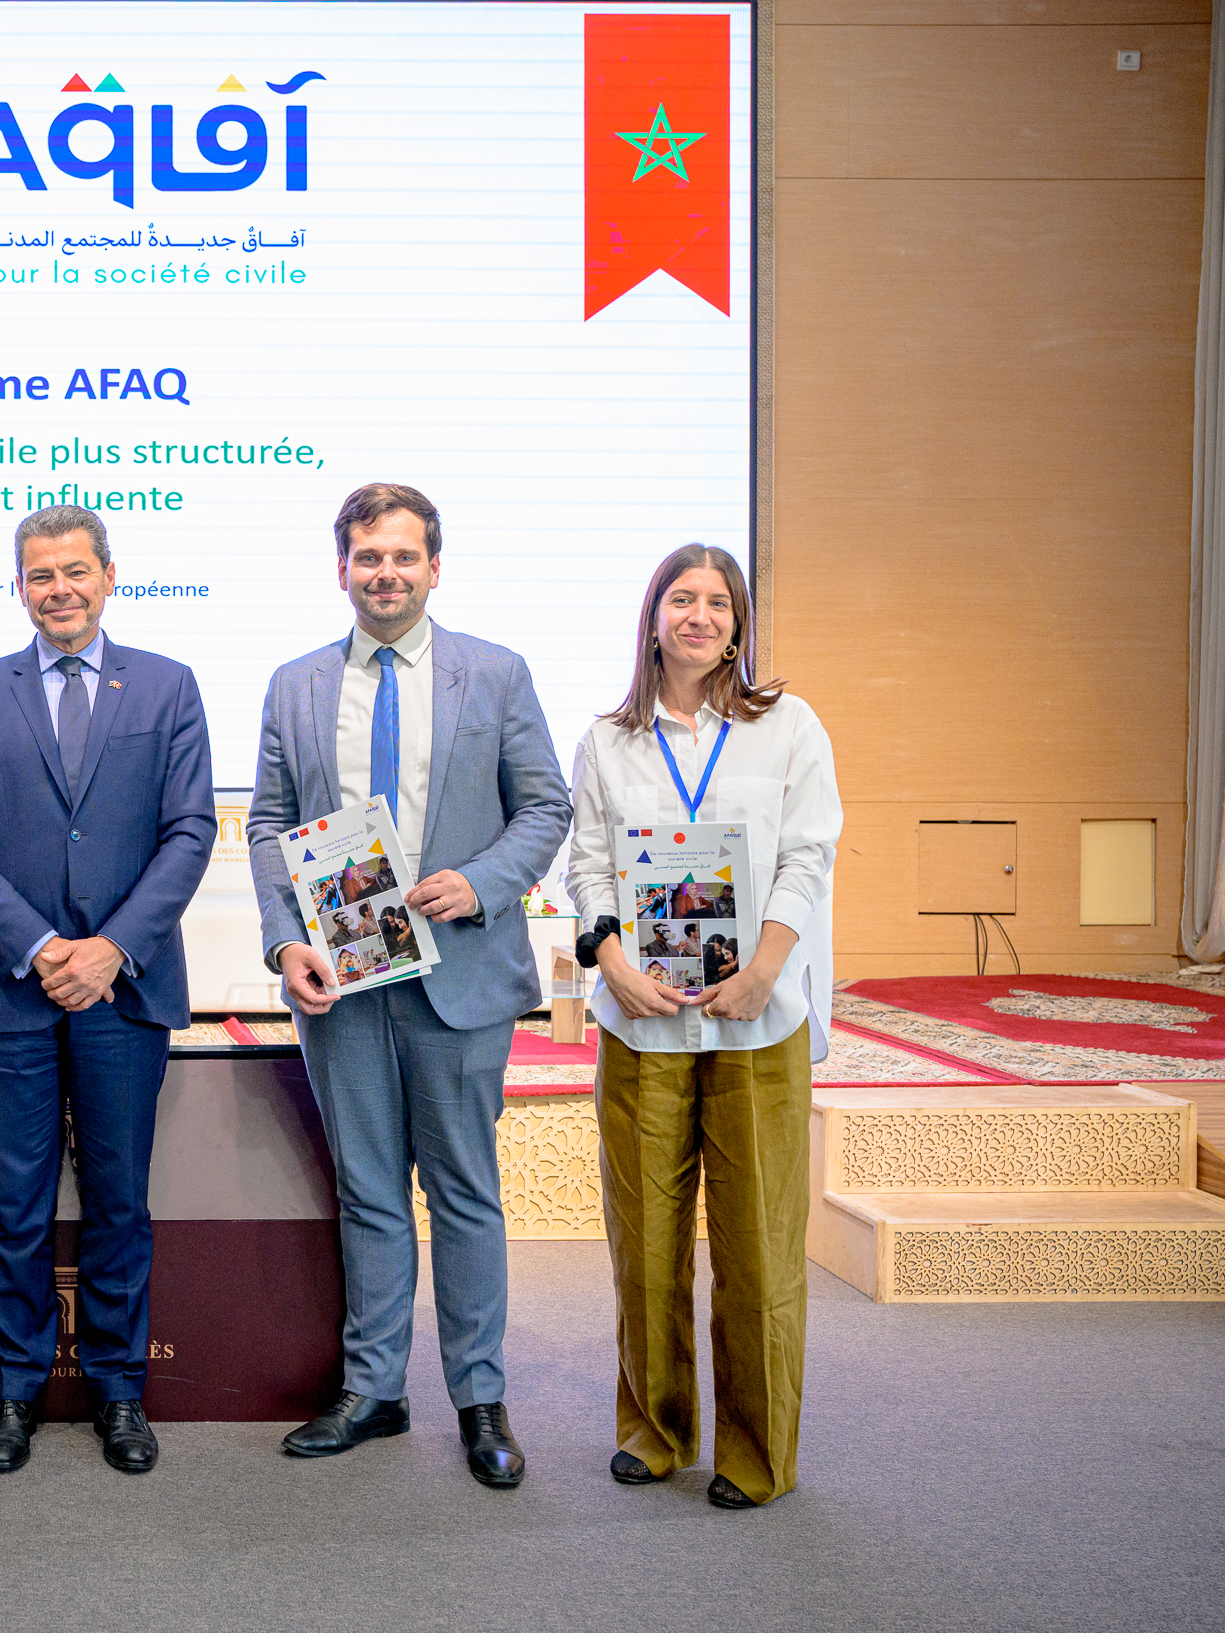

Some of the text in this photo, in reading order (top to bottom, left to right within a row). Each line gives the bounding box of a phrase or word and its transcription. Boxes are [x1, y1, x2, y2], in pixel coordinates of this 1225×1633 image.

[62, 230, 142, 256] للمجتمع
[54, 260, 79, 284] la
[94, 262, 211, 284] société
[225, 260, 307, 284] civile
[64, 368, 191, 406] AFAQ
[51, 437, 121, 471] plus
[133, 436, 325, 469] structurée,
[27, 484, 184, 511] influente
[114, 580, 210, 600] ropéenne
